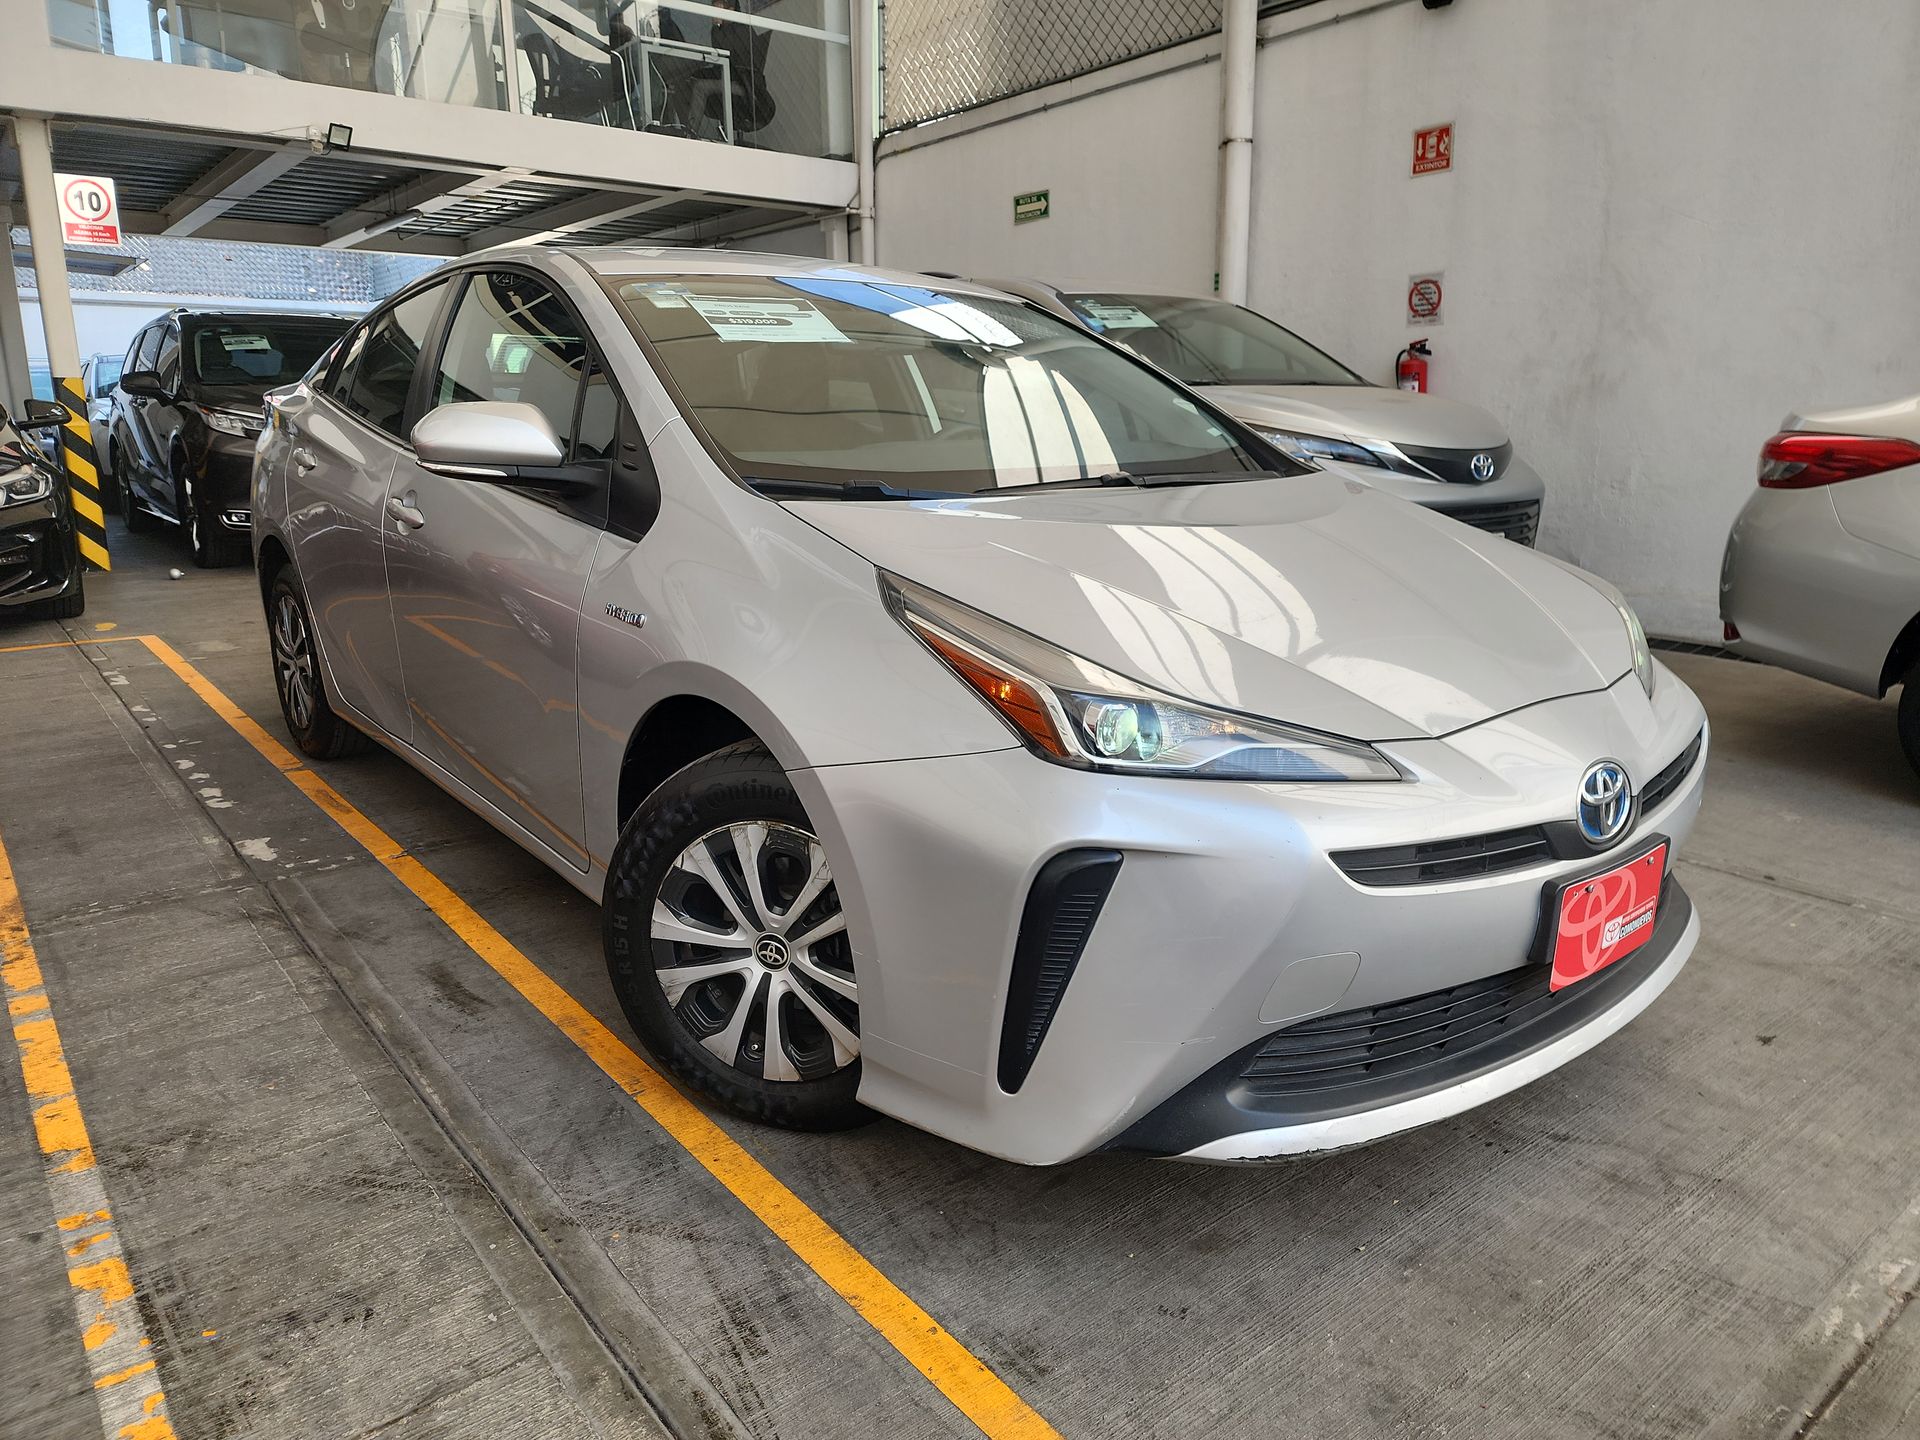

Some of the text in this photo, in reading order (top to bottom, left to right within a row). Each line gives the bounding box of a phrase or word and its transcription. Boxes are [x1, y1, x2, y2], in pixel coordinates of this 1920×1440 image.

[1415, 160, 1448, 172] EXTINTOR
[73, 190, 102, 212] 10
[1619, 909, 1653, 939] COMONUEVOS
